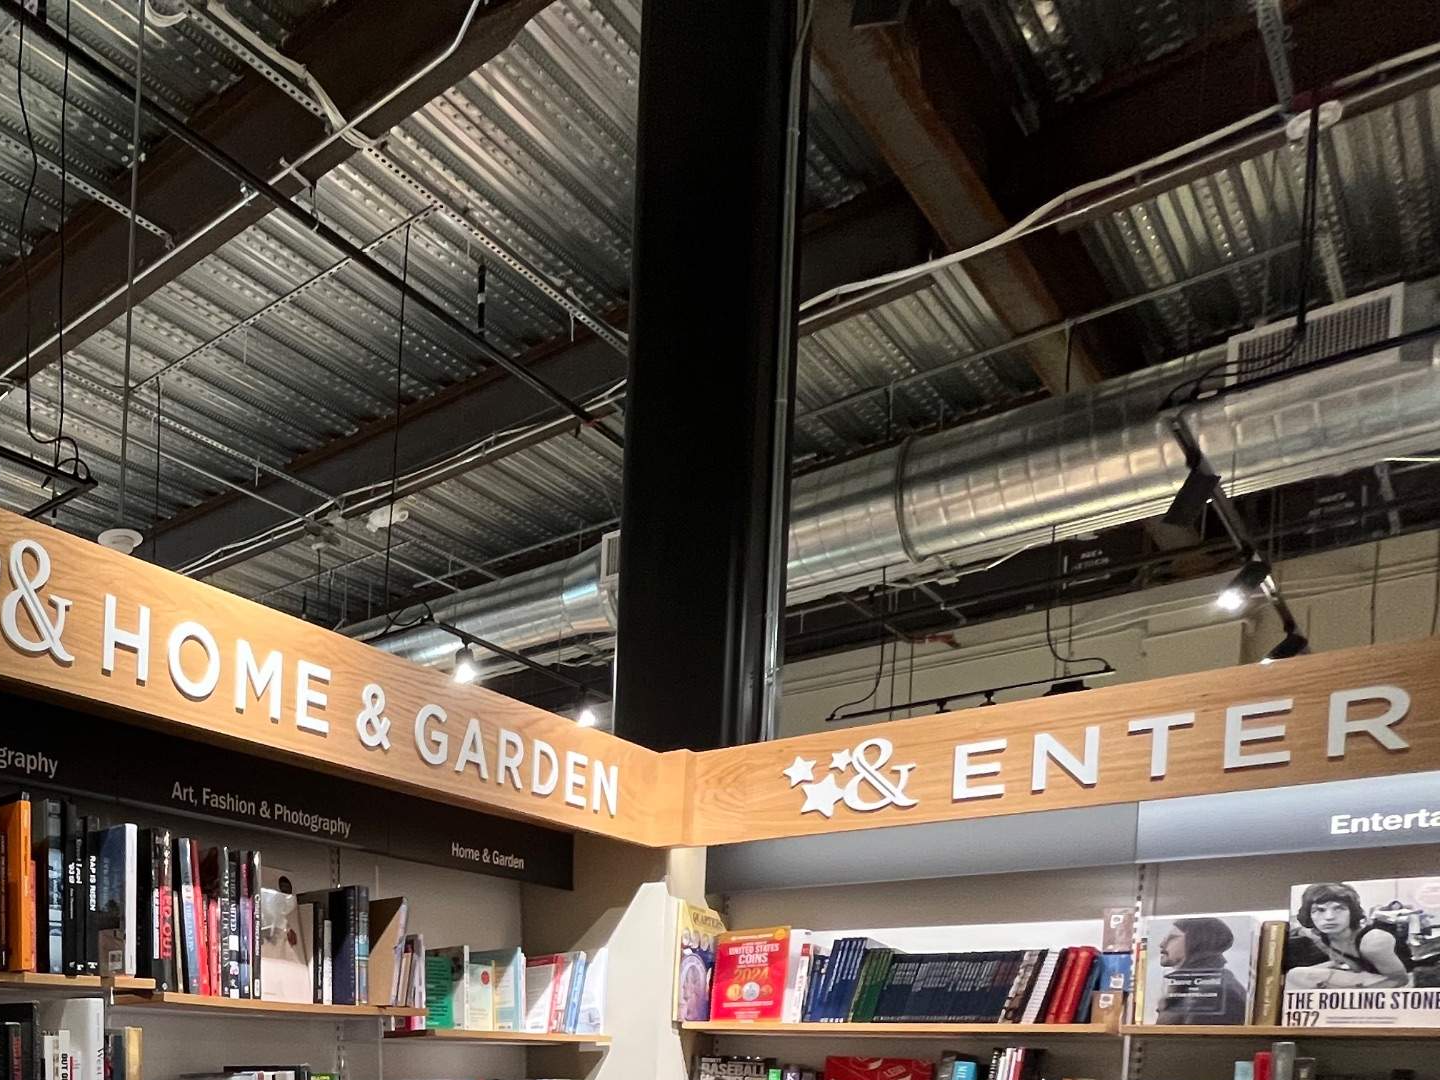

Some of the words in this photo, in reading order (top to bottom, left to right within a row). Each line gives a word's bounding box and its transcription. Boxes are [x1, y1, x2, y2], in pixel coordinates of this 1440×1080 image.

[0, 537, 76, 664] &
[101, 593, 332, 736] HOME
[357, 682, 393, 751] &
[414, 703, 621, 817] GARDEN
[842, 737, 920, 812] &
[951, 684, 1411, 802] ENTER
[171, 780, 199, 806] Art,
[202, 786, 257, 818] Fashion
[259, 800, 272, 820] &
[273, 803, 352, 840] Photography
[450, 841, 481, 863] Home
[482, 849, 492, 865] &
[491, 850, 525, 871] Garden
[89, 873, 96, 883] IS
[728, 944, 755, 956] UNITED
[755, 943, 780, 953] STATES
[738, 952, 769, 965] COINS
[733, 968, 770, 982] 2024
[1286, 992, 1314, 1010] THE
[1318, 991, 1386, 1010] ROLLING
[1391, 990, 1440, 1010] STONE
[1284, 1010, 1320, 1027] 1972
[60, 1052, 69, 1072] OUT
[96, 1046, 105, 1076] West
[699, 1061, 767, 1078] BASEBALL
